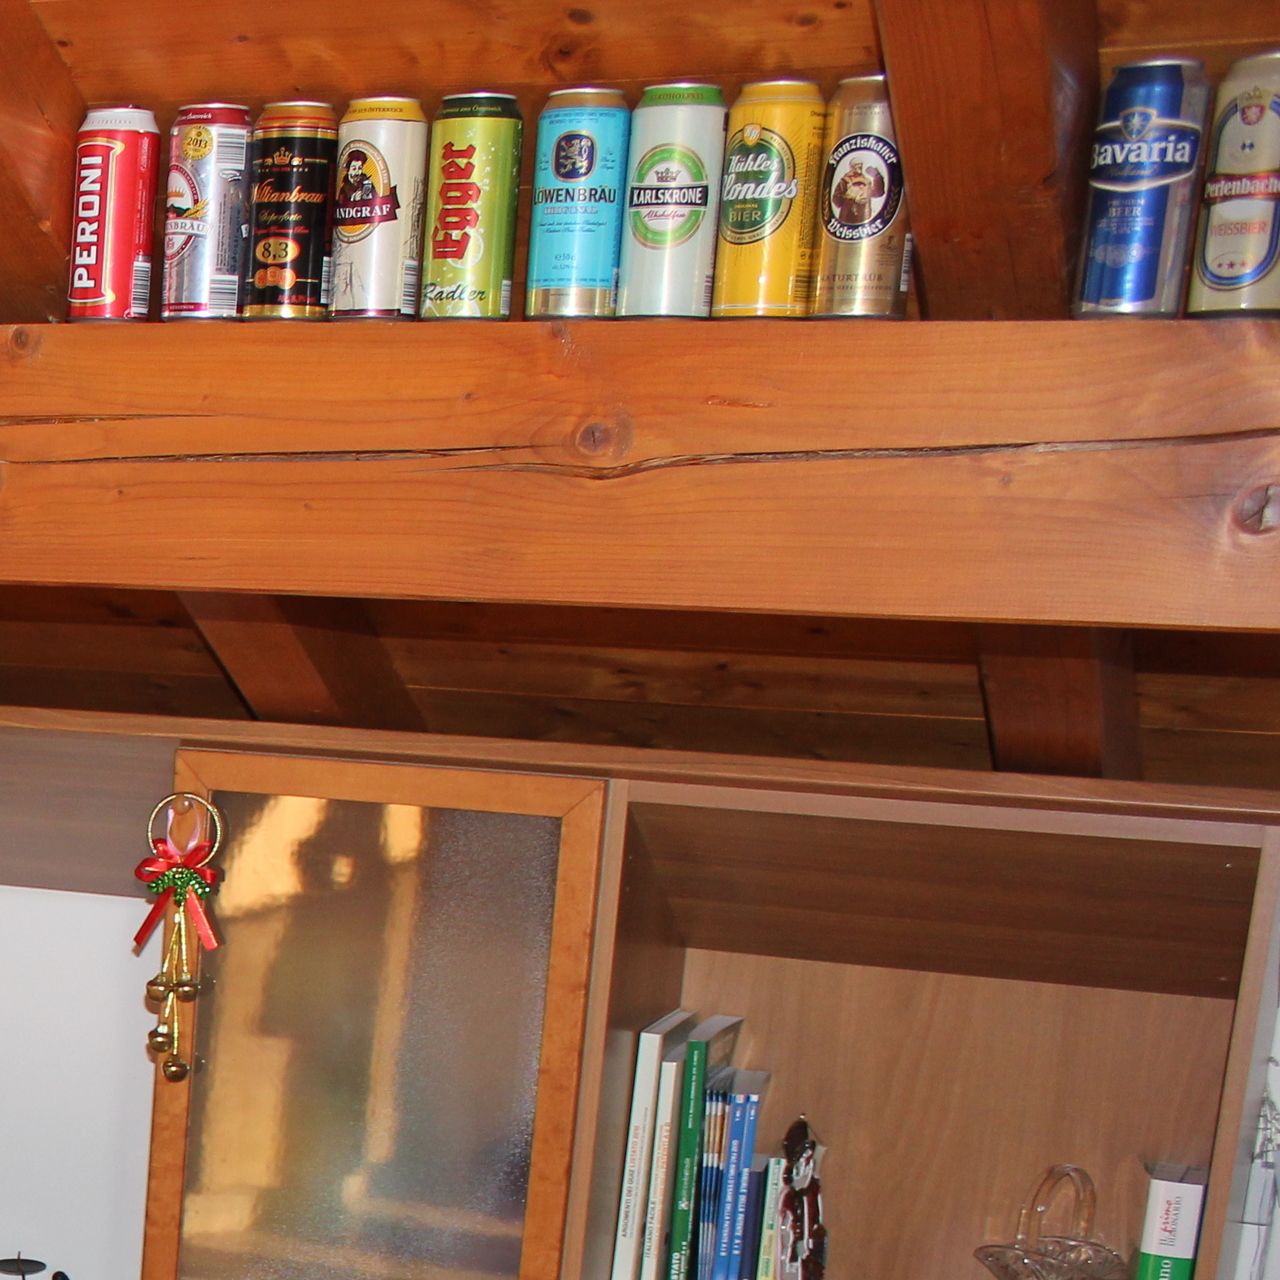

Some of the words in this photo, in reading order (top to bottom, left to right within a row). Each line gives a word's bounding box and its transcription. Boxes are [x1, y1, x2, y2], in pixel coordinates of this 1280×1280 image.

[186, 136, 208, 149] 2013
[828, 136, 897, 168] Franziskaner
[728, 153, 780, 173] Kühles
[431, 140, 482, 260] Egger
[632, 187, 702, 205] KARLSKRONE
[73, 155, 103, 289] PERONI
[729, 211, 762, 222] BIER
[827, 218, 884, 240] Weissbier
[262, 242, 289, 259] 8,3
[422, 281, 487, 302] Radler
